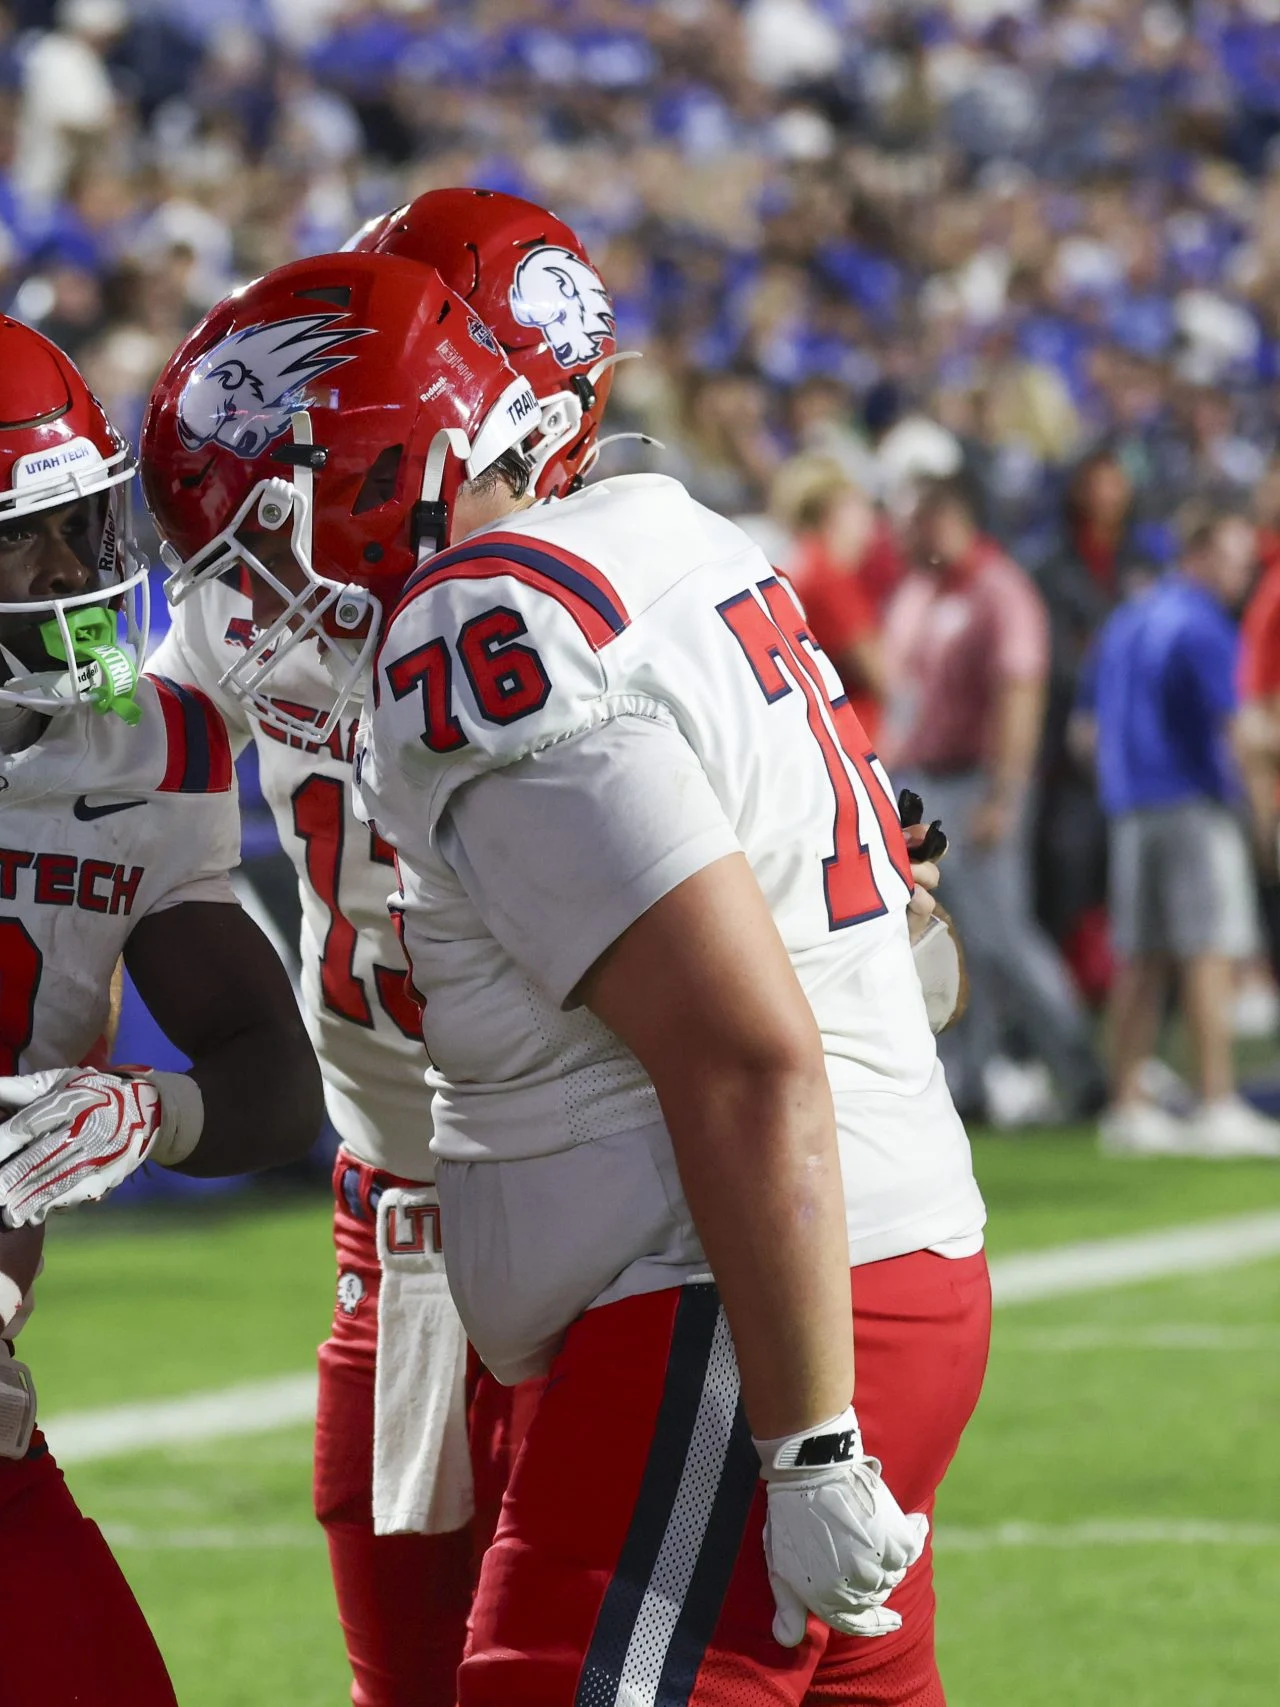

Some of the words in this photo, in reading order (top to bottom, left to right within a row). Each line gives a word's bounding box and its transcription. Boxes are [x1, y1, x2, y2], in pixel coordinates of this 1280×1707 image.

[420, 376, 446, 402] Riddell
[25, 456, 61, 475] UTAH
[62, 447, 90, 464] TECH
[77, 663, 99, 683] iddell
[385, 605, 553, 753] 76
[715, 576, 915, 932] 76
[794, 1429, 856, 1467] NIKE
